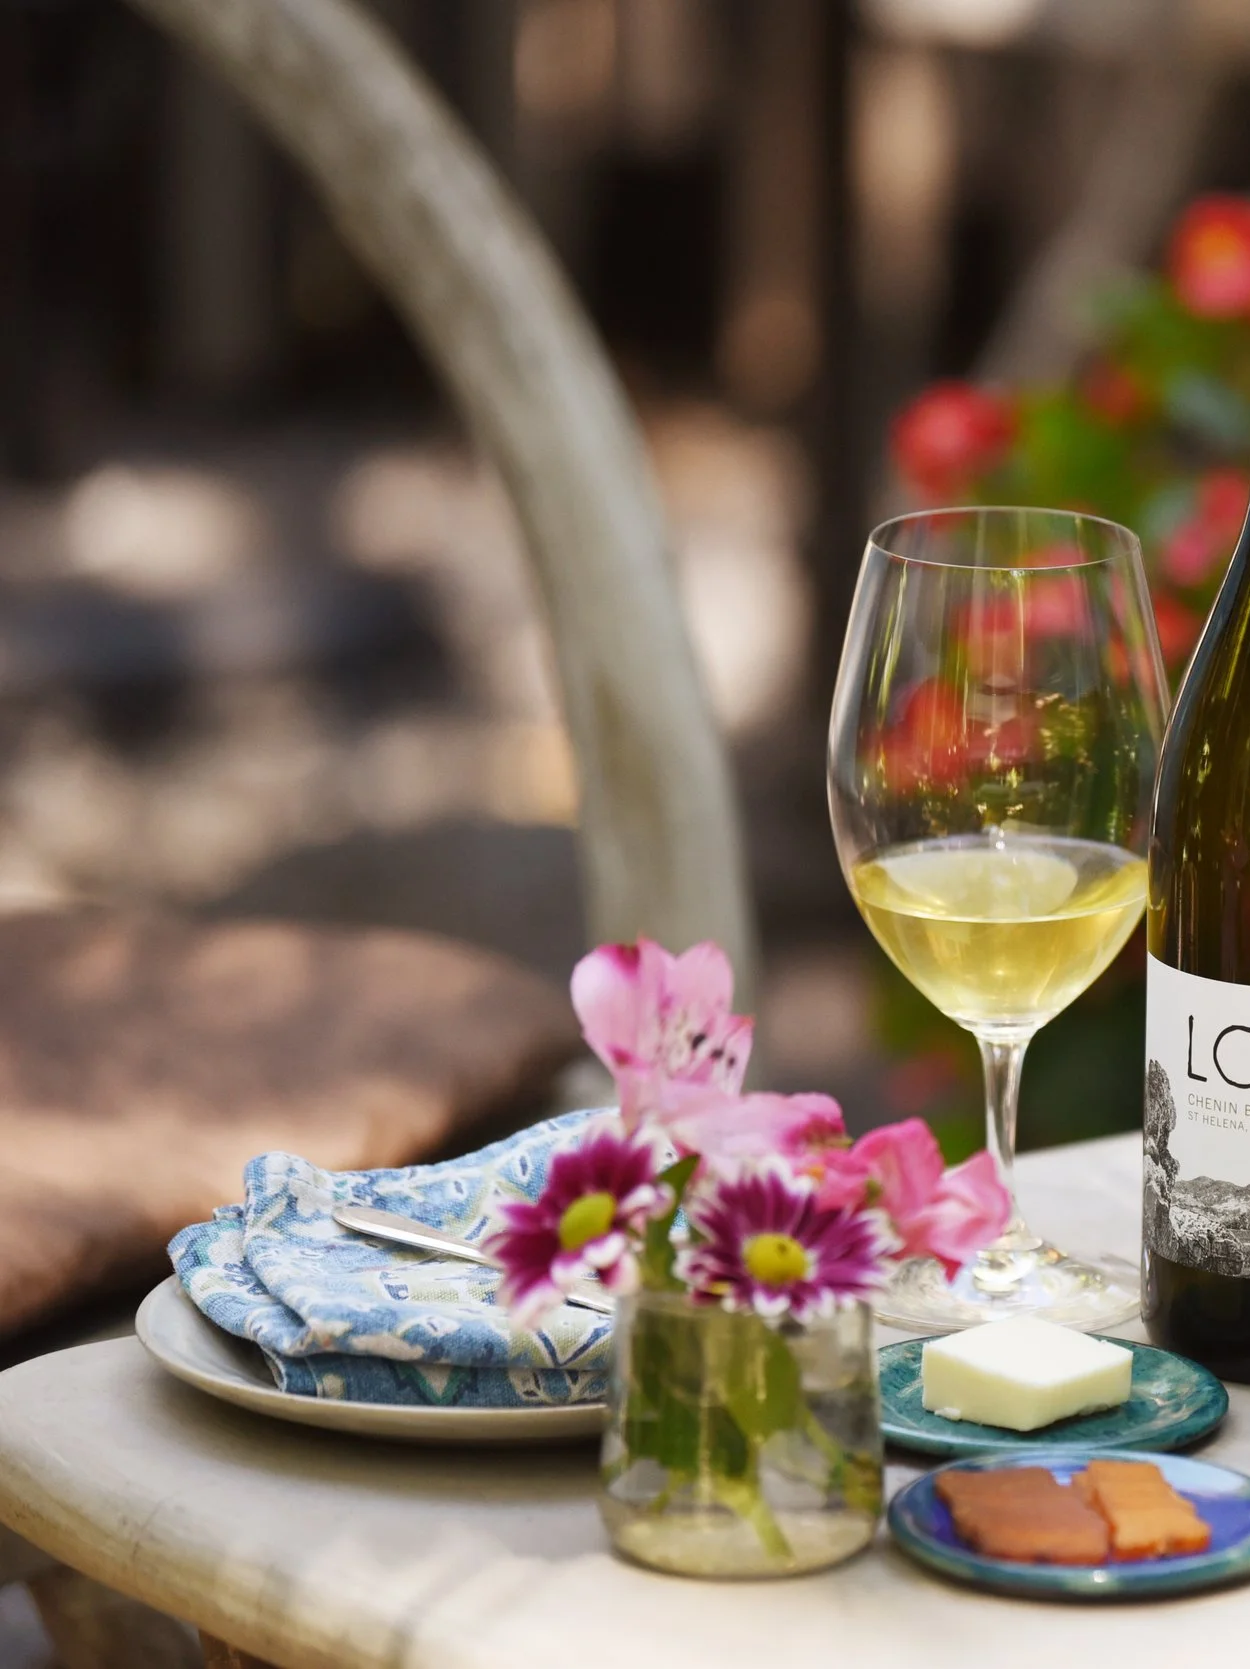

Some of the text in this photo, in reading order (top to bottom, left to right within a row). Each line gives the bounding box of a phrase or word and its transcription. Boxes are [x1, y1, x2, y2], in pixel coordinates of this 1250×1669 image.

[1188, 1093, 1238, 1114] CHENIN
[1188, 1111, 1199, 1120] ST
[1202, 1114, 1248, 1132] HELENA,
